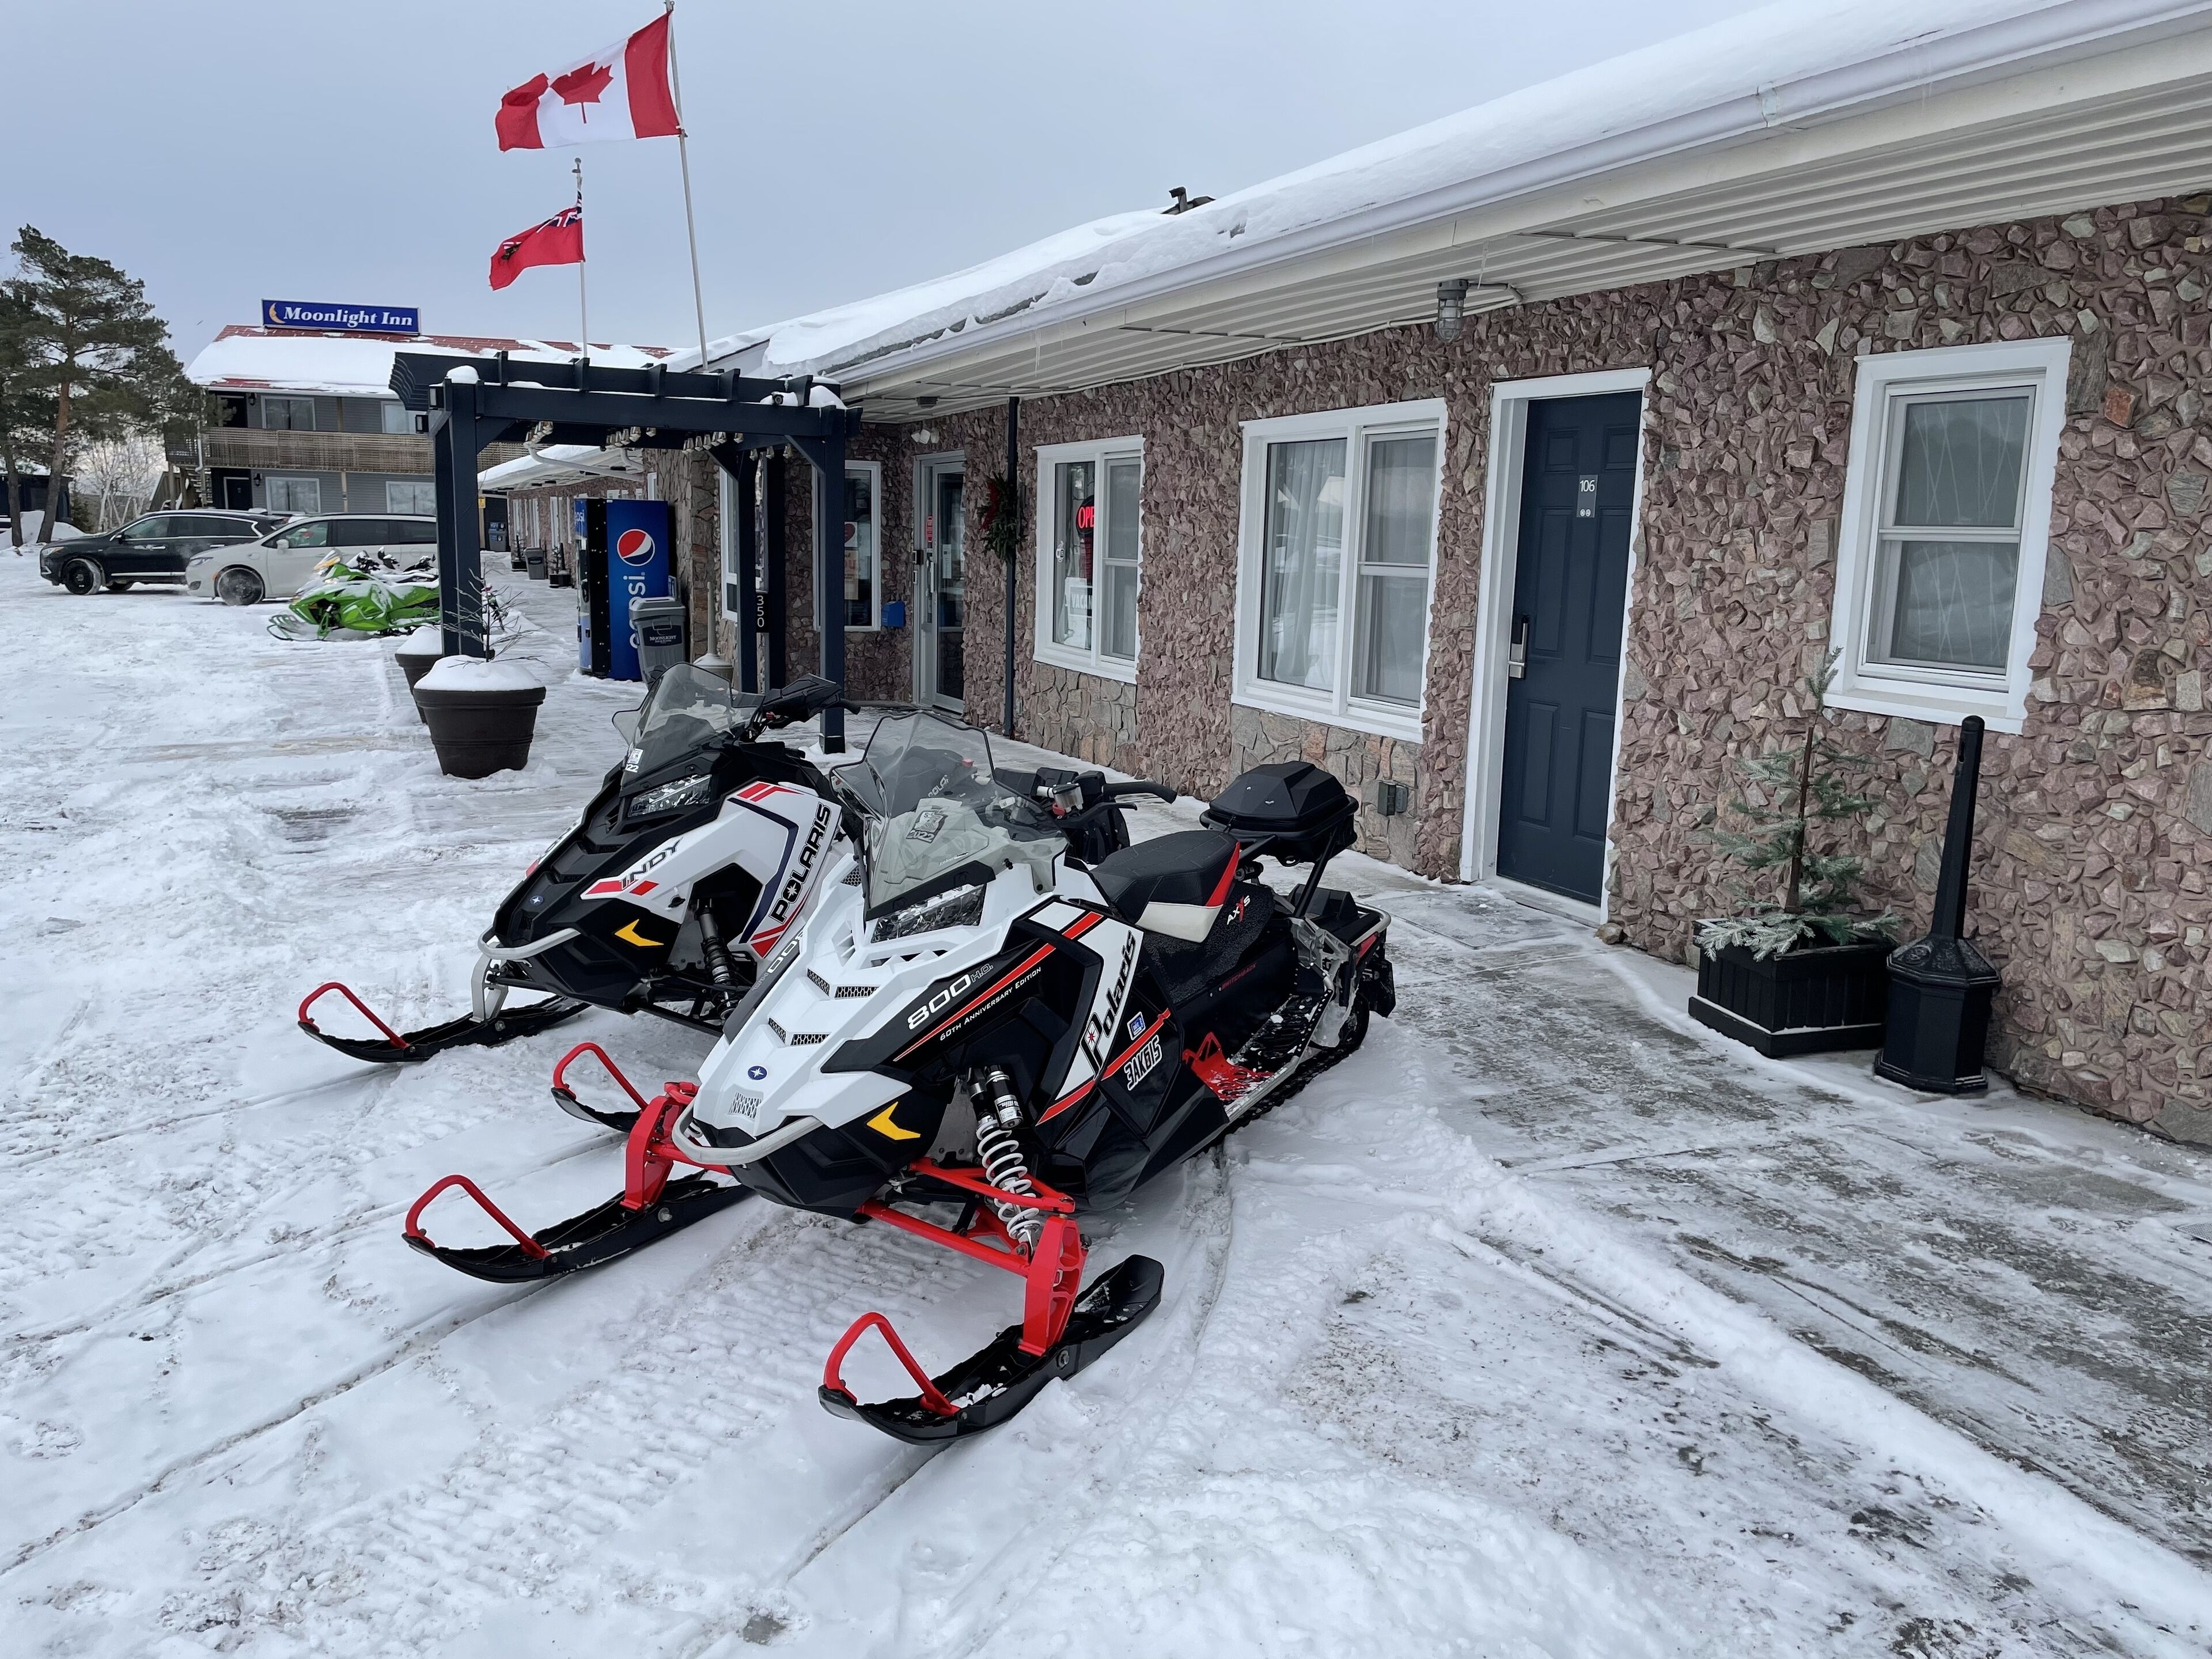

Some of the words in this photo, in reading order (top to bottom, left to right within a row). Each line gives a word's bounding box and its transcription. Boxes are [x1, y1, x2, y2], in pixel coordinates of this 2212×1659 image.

[283, 306, 377, 328] Moonlight
[381, 311, 412, 326] Inn
[1580, 479, 1595, 493] 106
[1078, 506, 1095, 529] OPE
[756, 594, 765, 628] 350
[1071, 593, 1093, 609] VACAN
[906, 830, 935, 843] 2022
[622, 836, 684, 890] INDY
[768, 801, 832, 925] POLARIS
[907, 974, 971, 1030] 800
[940, 1022, 961, 1041] 60TH
[964, 987, 1013, 1025] ANNIVERSARY
[1015, 967, 1041, 989] EDITION
[1080, 930, 1136, 1081] Polaris
